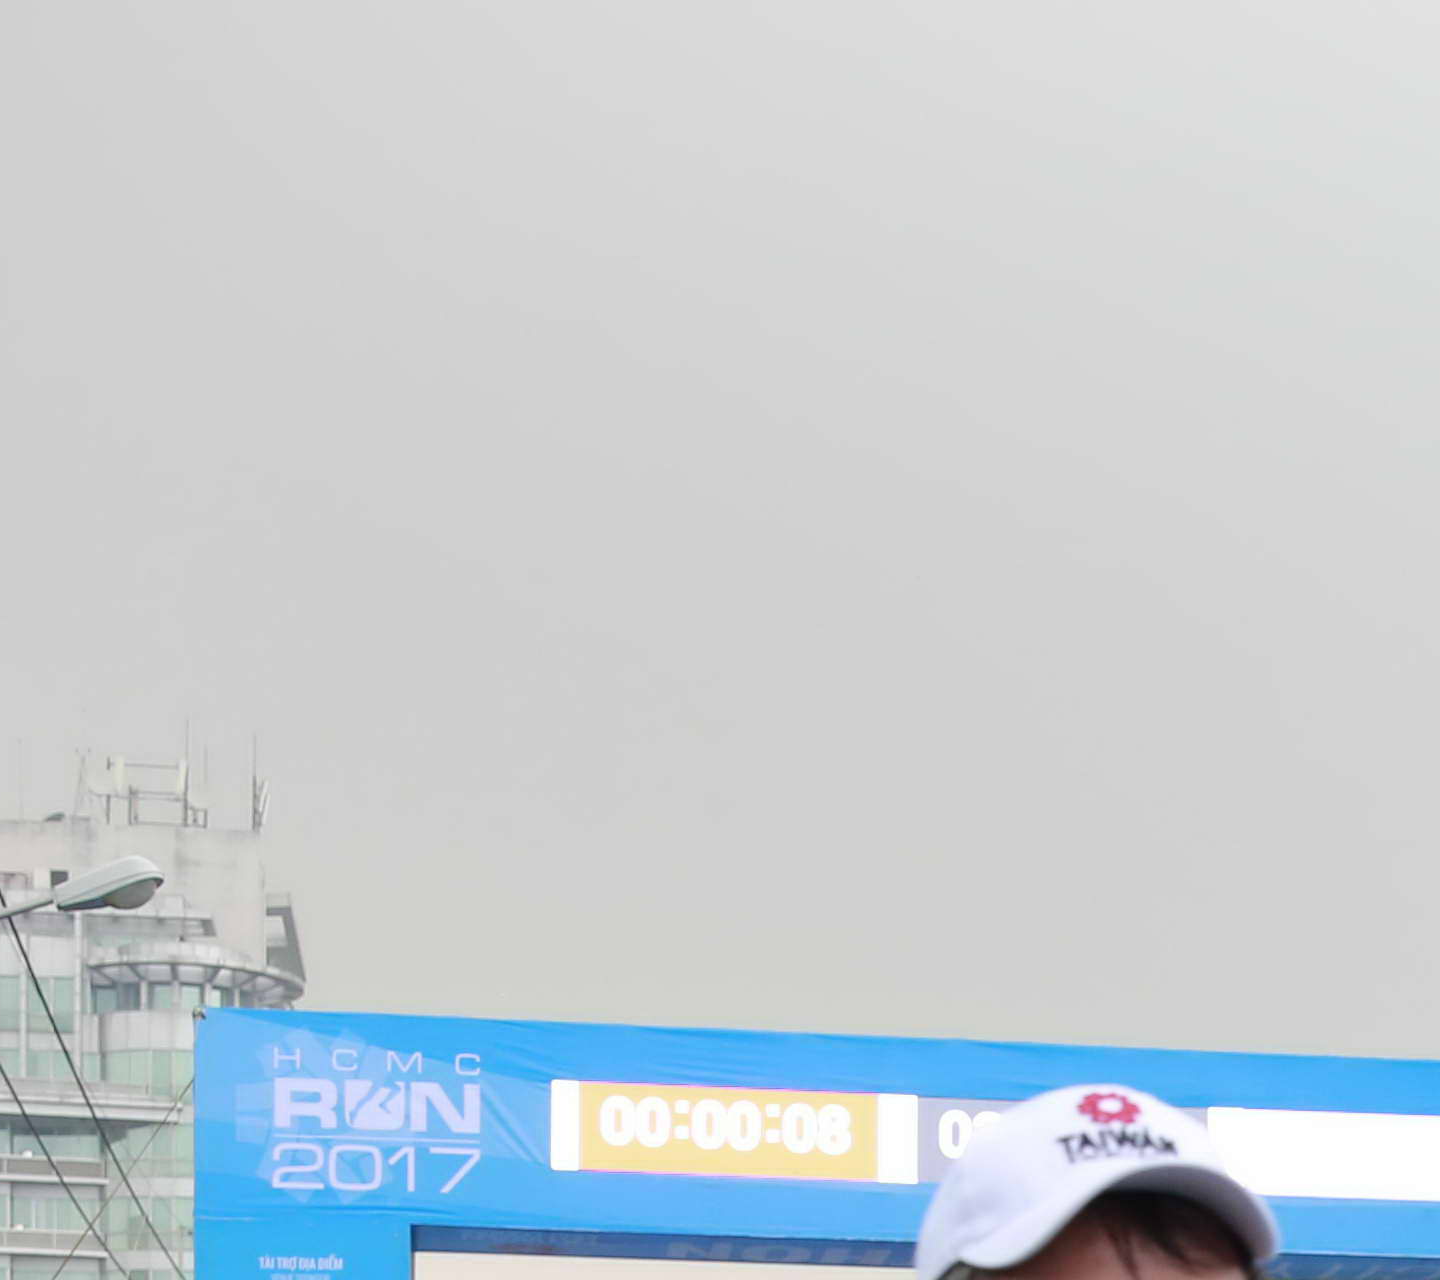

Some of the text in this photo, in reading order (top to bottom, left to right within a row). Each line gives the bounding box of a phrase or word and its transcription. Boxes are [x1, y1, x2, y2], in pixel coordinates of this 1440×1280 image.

[272, 1078, 482, 1134] RUN
[599, 1094, 853, 1156] 00:00:08
[271, 1144, 481, 1193] 2017
